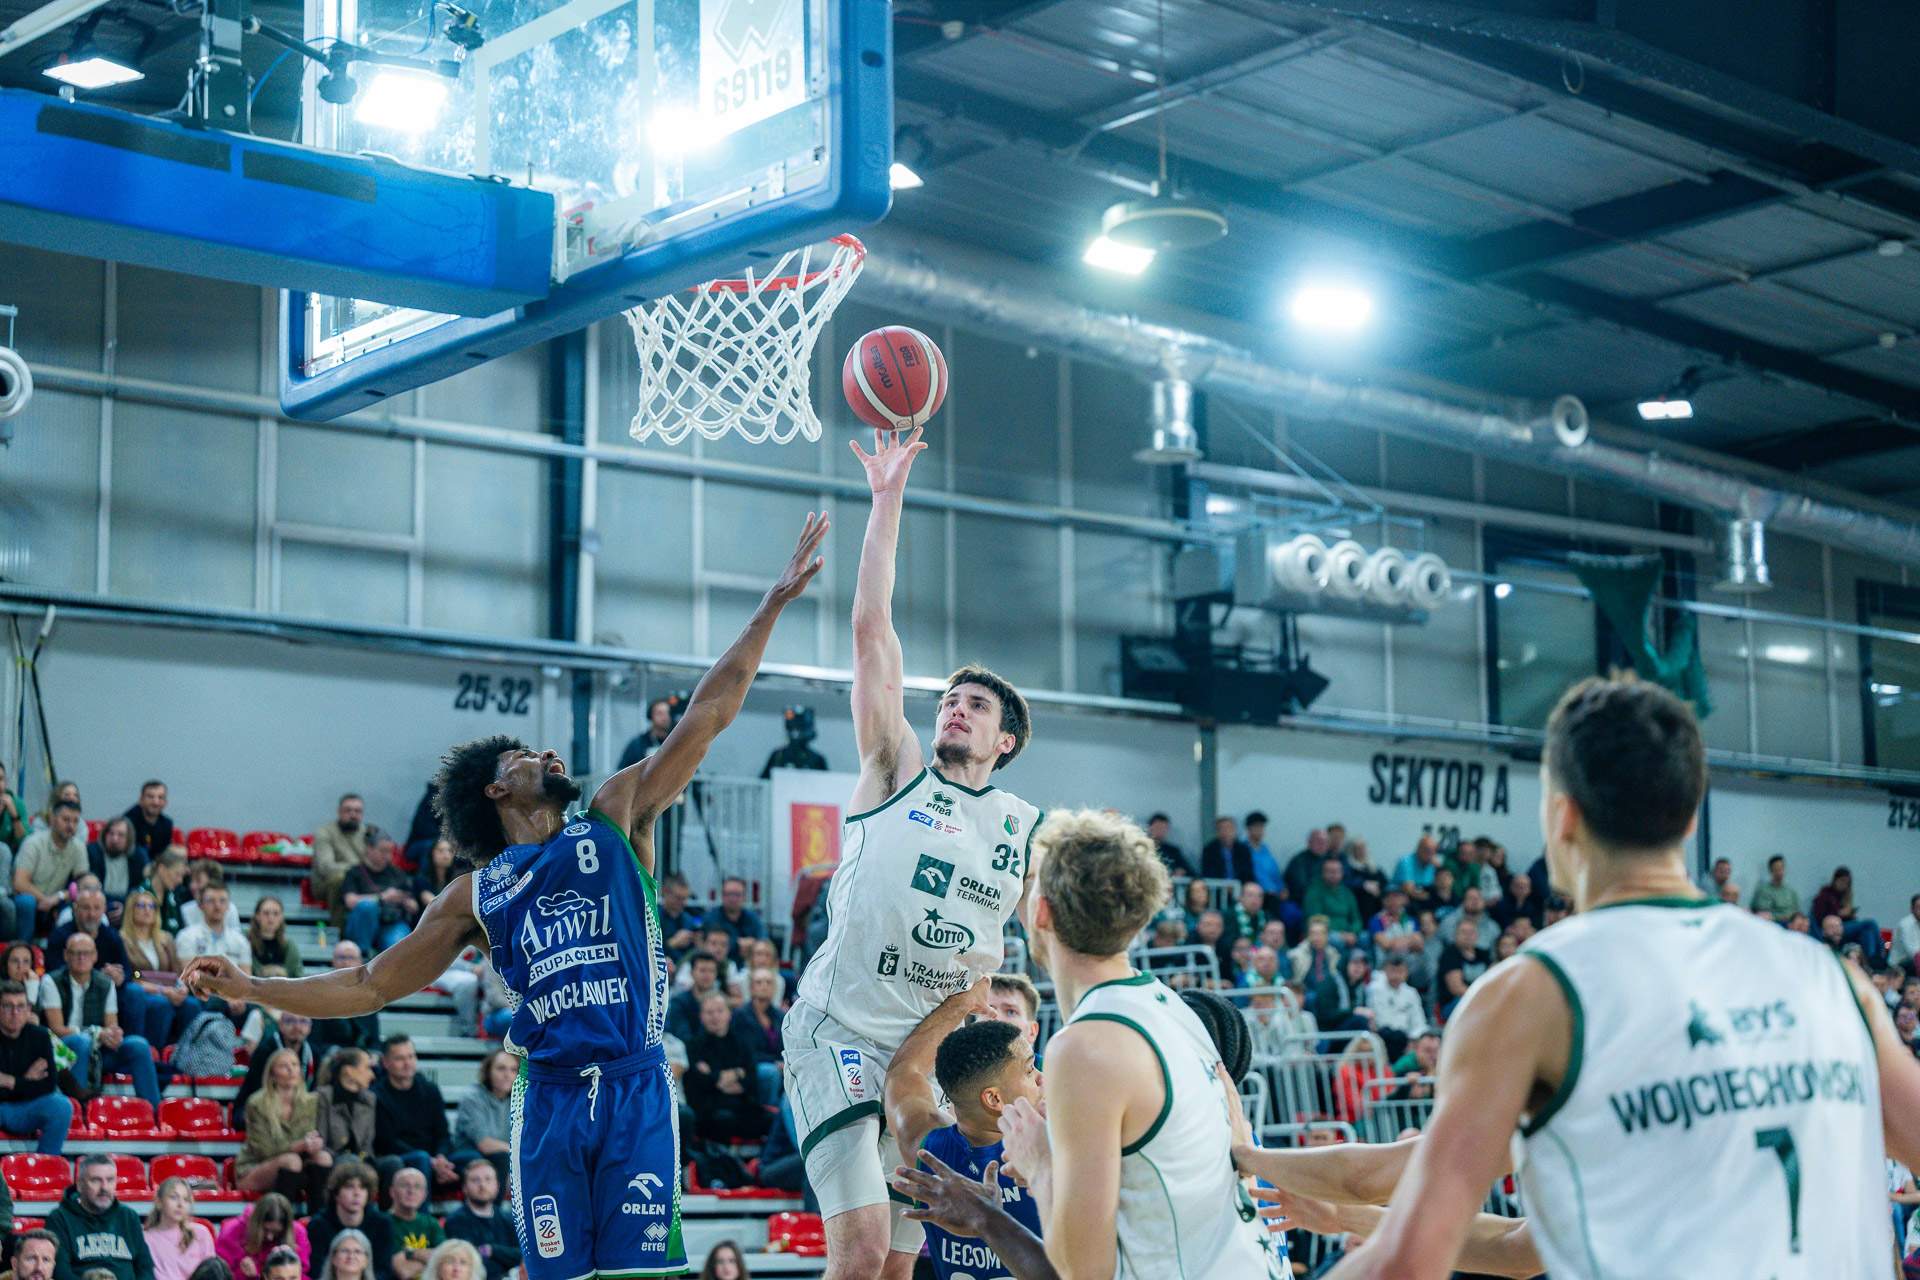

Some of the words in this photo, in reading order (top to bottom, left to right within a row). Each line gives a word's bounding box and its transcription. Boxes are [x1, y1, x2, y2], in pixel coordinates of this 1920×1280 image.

[455, 672, 532, 714] 25-32
[1369, 753, 1483, 810] SEKTOR
[1491, 764, 1509, 814] A
[576, 838, 600, 874] 8
[991, 843, 1020, 879] 32
[956, 888, 1001, 912] TERMIKA
[960, 876, 1001, 900] ORLEN
[520, 894, 612, 965] Anwil
[925, 924, 964, 944] LOTTO
[529, 953, 574, 981] GRUPA
[575, 946, 615, 962] ORLEN
[526, 977, 630, 1025] WŁOCŁAWEK
[1609, 1060, 1867, 1134] WOJCIECHOSK
[1755, 1125, 1801, 1254] 7
[535, 1203, 553, 1213] PGE
[621, 1202, 666, 1215] ORLEN
[539, 1240, 560, 1248] Basket
[641, 1241, 666, 1252] errea
[941, 1238, 1002, 1270] LECOM
